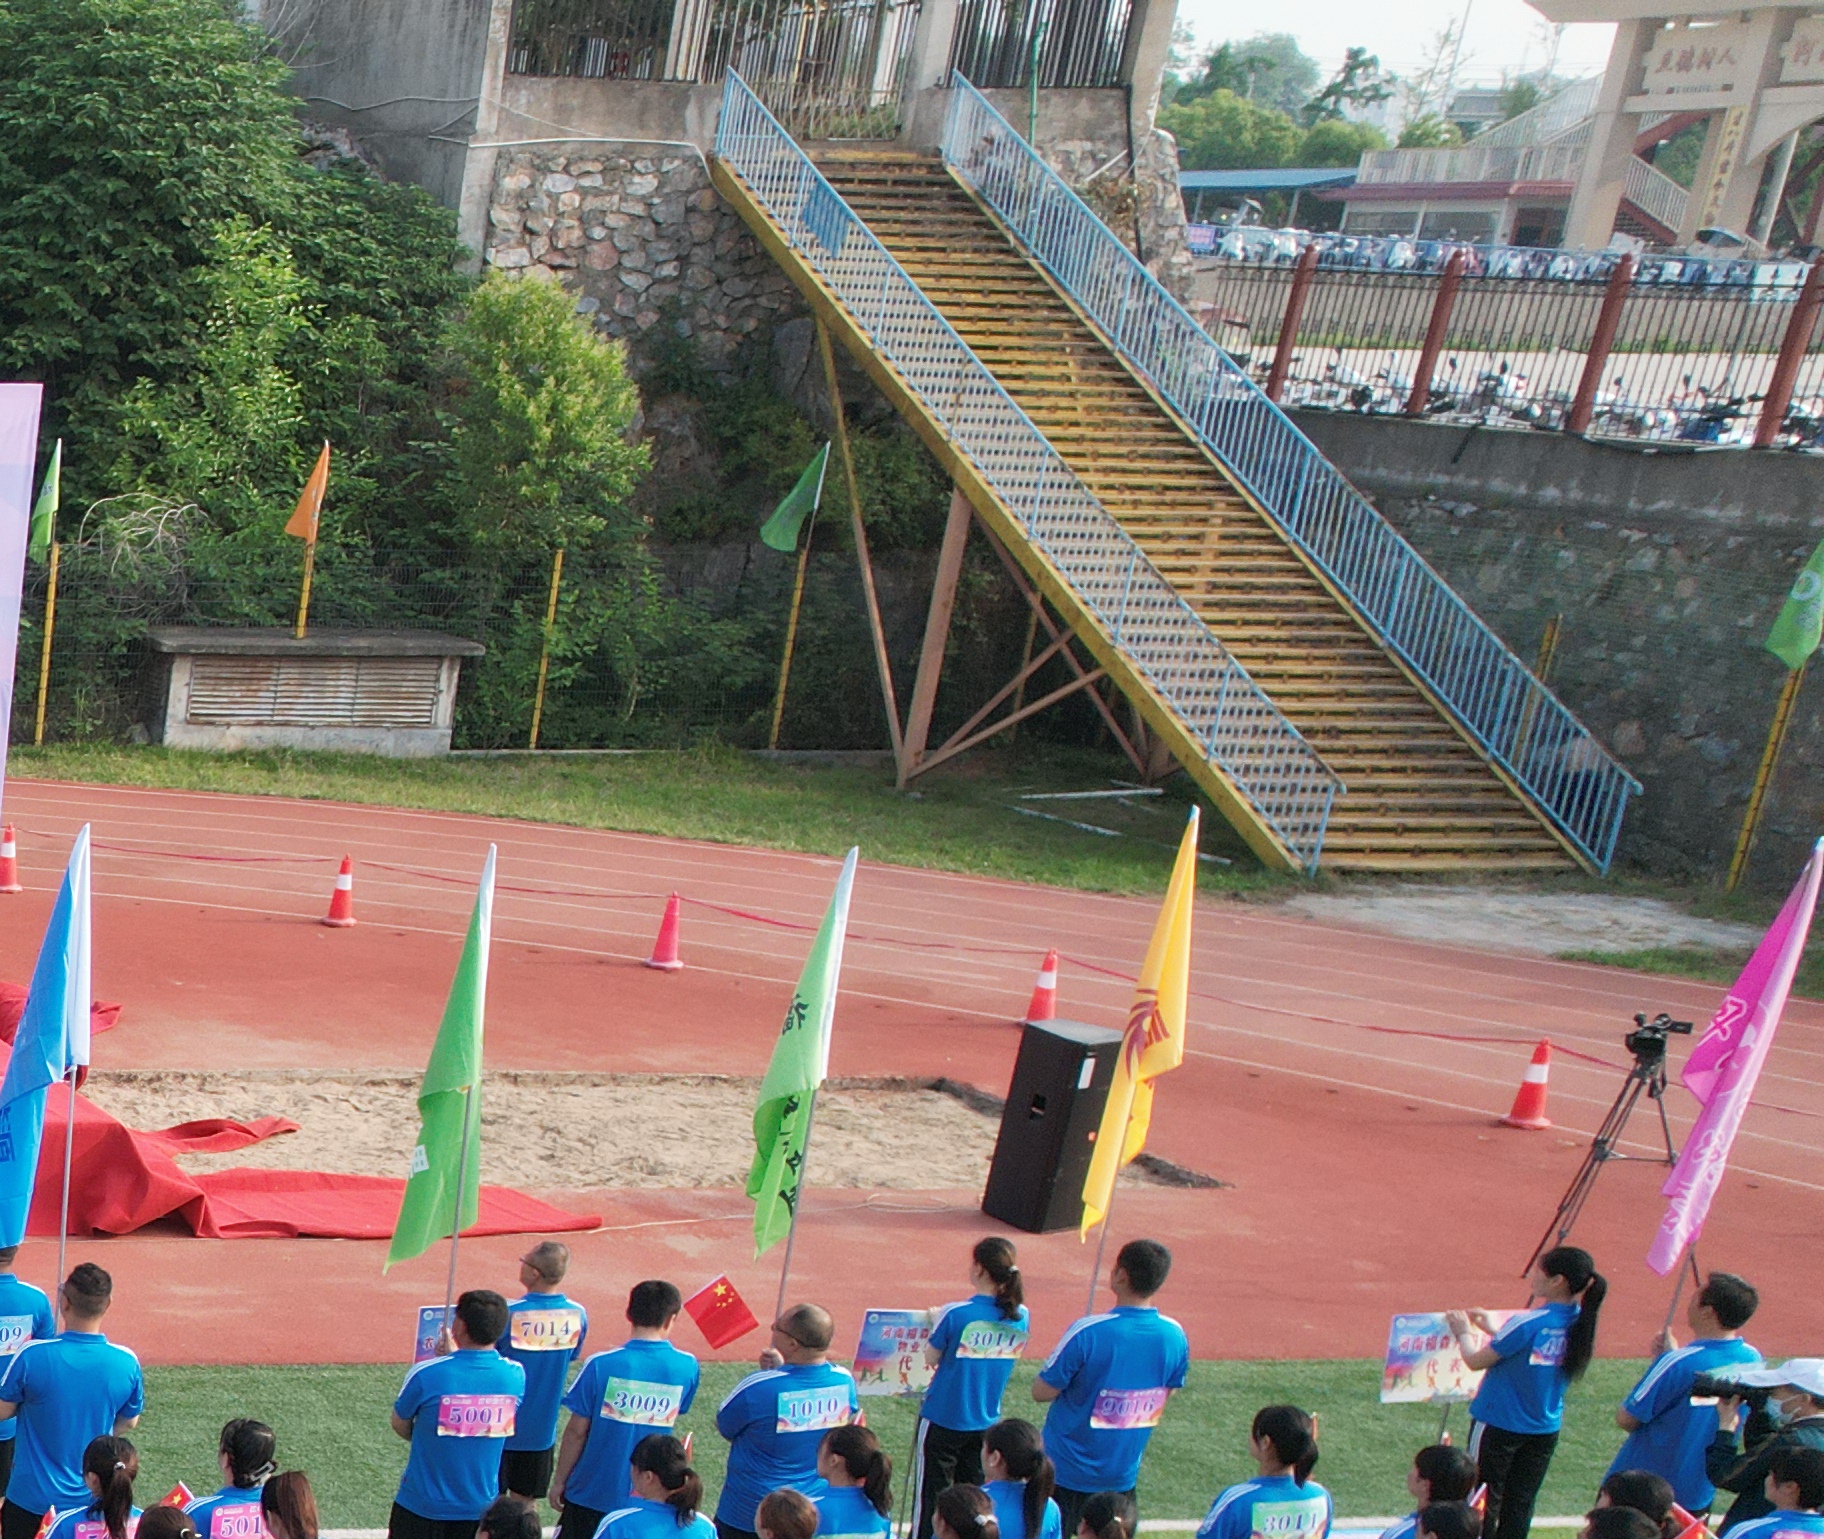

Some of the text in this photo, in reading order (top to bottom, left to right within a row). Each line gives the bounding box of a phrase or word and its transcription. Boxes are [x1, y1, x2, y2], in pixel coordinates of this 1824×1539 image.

[519, 1319, 571, 1338] 7014
[968, 1333, 1018, 1352] 3011
[613, 1389, 670, 1413] 3009
[786, 1395, 838, 1416] 1010
[449, 1404, 505, 1425] 5001
[219, 1509, 261, 1533] 501
[1263, 1509, 1318, 1532] 3011
